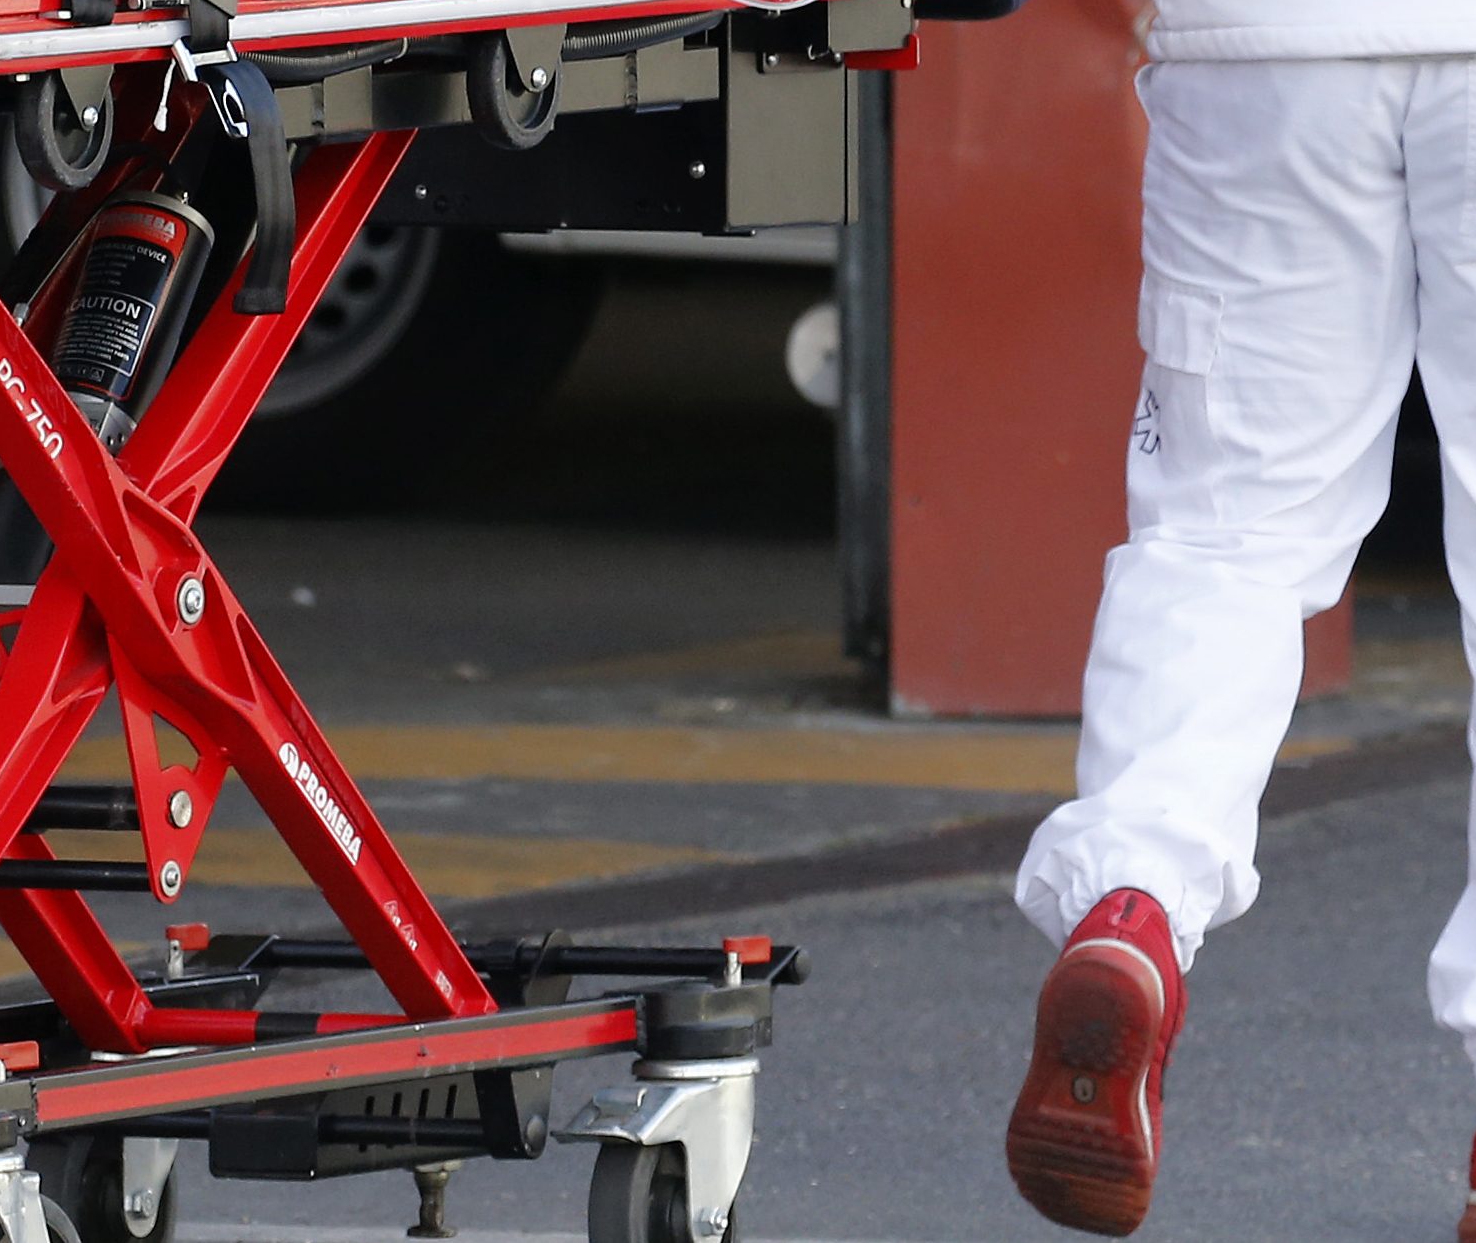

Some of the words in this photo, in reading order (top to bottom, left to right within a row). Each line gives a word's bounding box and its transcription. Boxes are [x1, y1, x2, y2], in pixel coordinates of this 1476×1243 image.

[136, 245, 168, 264] DEVICE
[70, 296, 141, 319] CAUTION
[297, 760, 363, 863] PROMEBA
